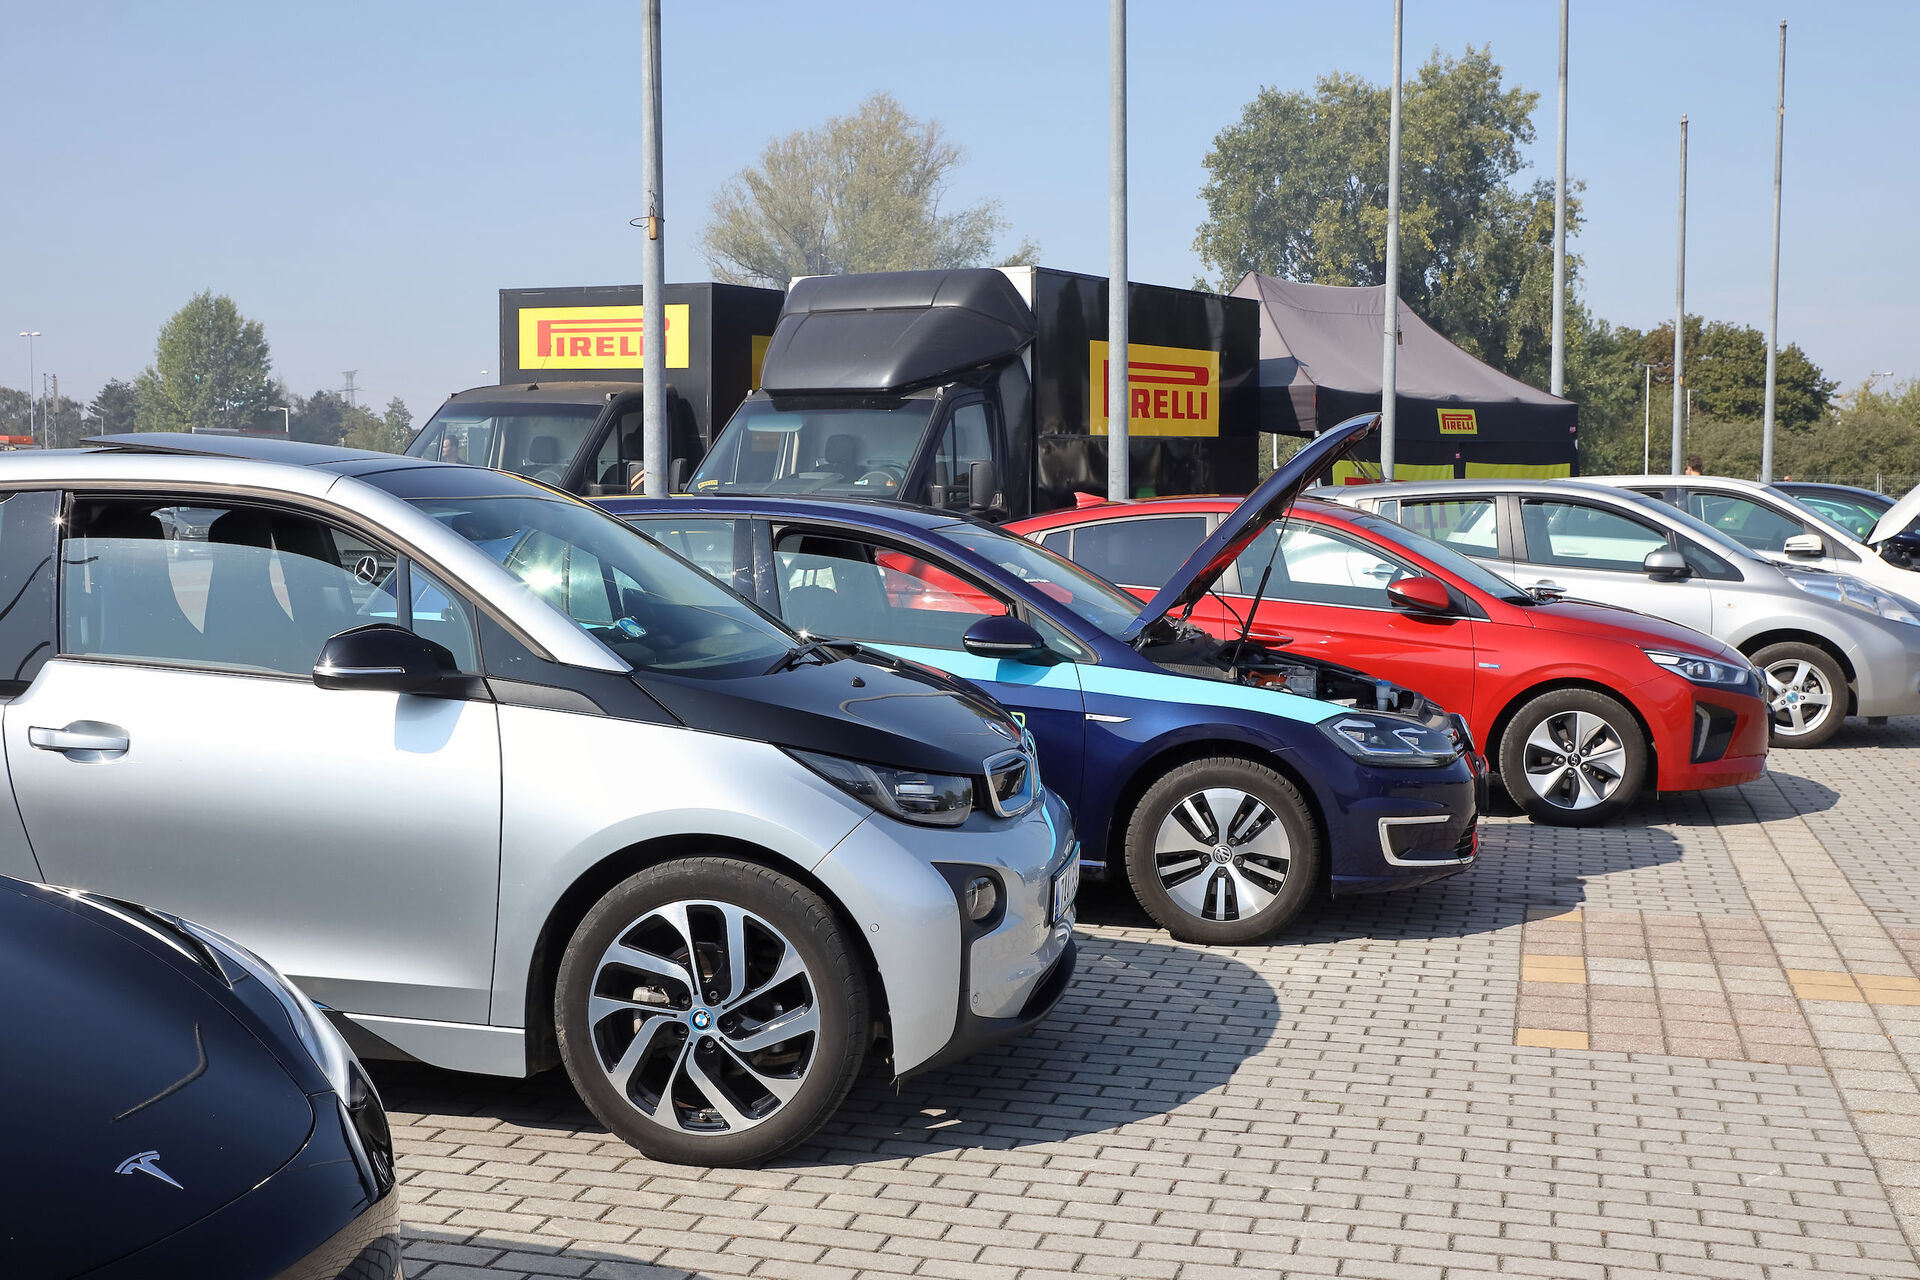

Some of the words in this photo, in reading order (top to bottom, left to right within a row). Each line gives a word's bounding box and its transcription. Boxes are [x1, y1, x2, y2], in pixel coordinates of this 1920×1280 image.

[537, 317, 670, 357] PIREL
[1103, 359, 1210, 420] PRELLI
[1441, 413, 1475, 431] PIRELLI
